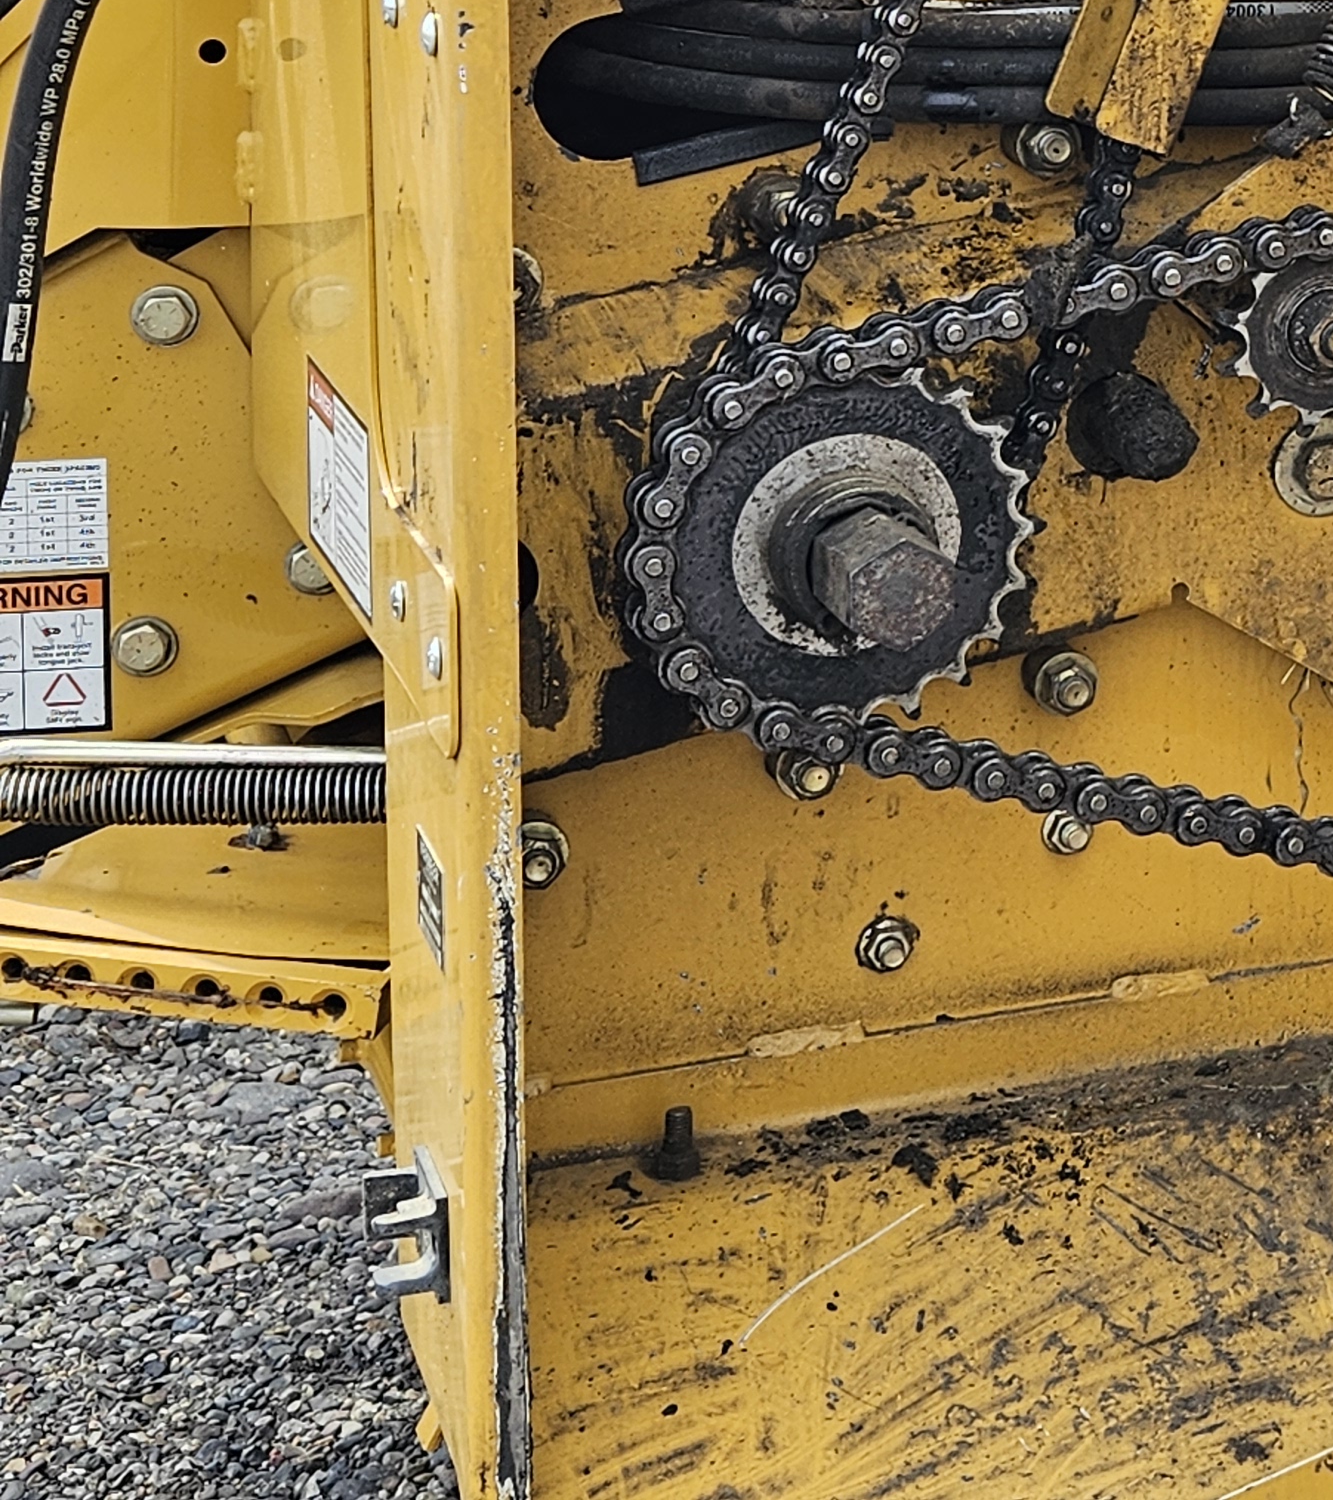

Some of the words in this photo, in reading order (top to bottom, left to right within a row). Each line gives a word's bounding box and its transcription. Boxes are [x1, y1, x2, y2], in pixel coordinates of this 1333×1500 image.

[59, 8, 87, 45] MPa
[48, 47, 72, 84] 28.0
[39, 87, 60, 116] WP
[16, 215, 40, 299] 302/301-8
[9, 305, 29, 356] Parker
